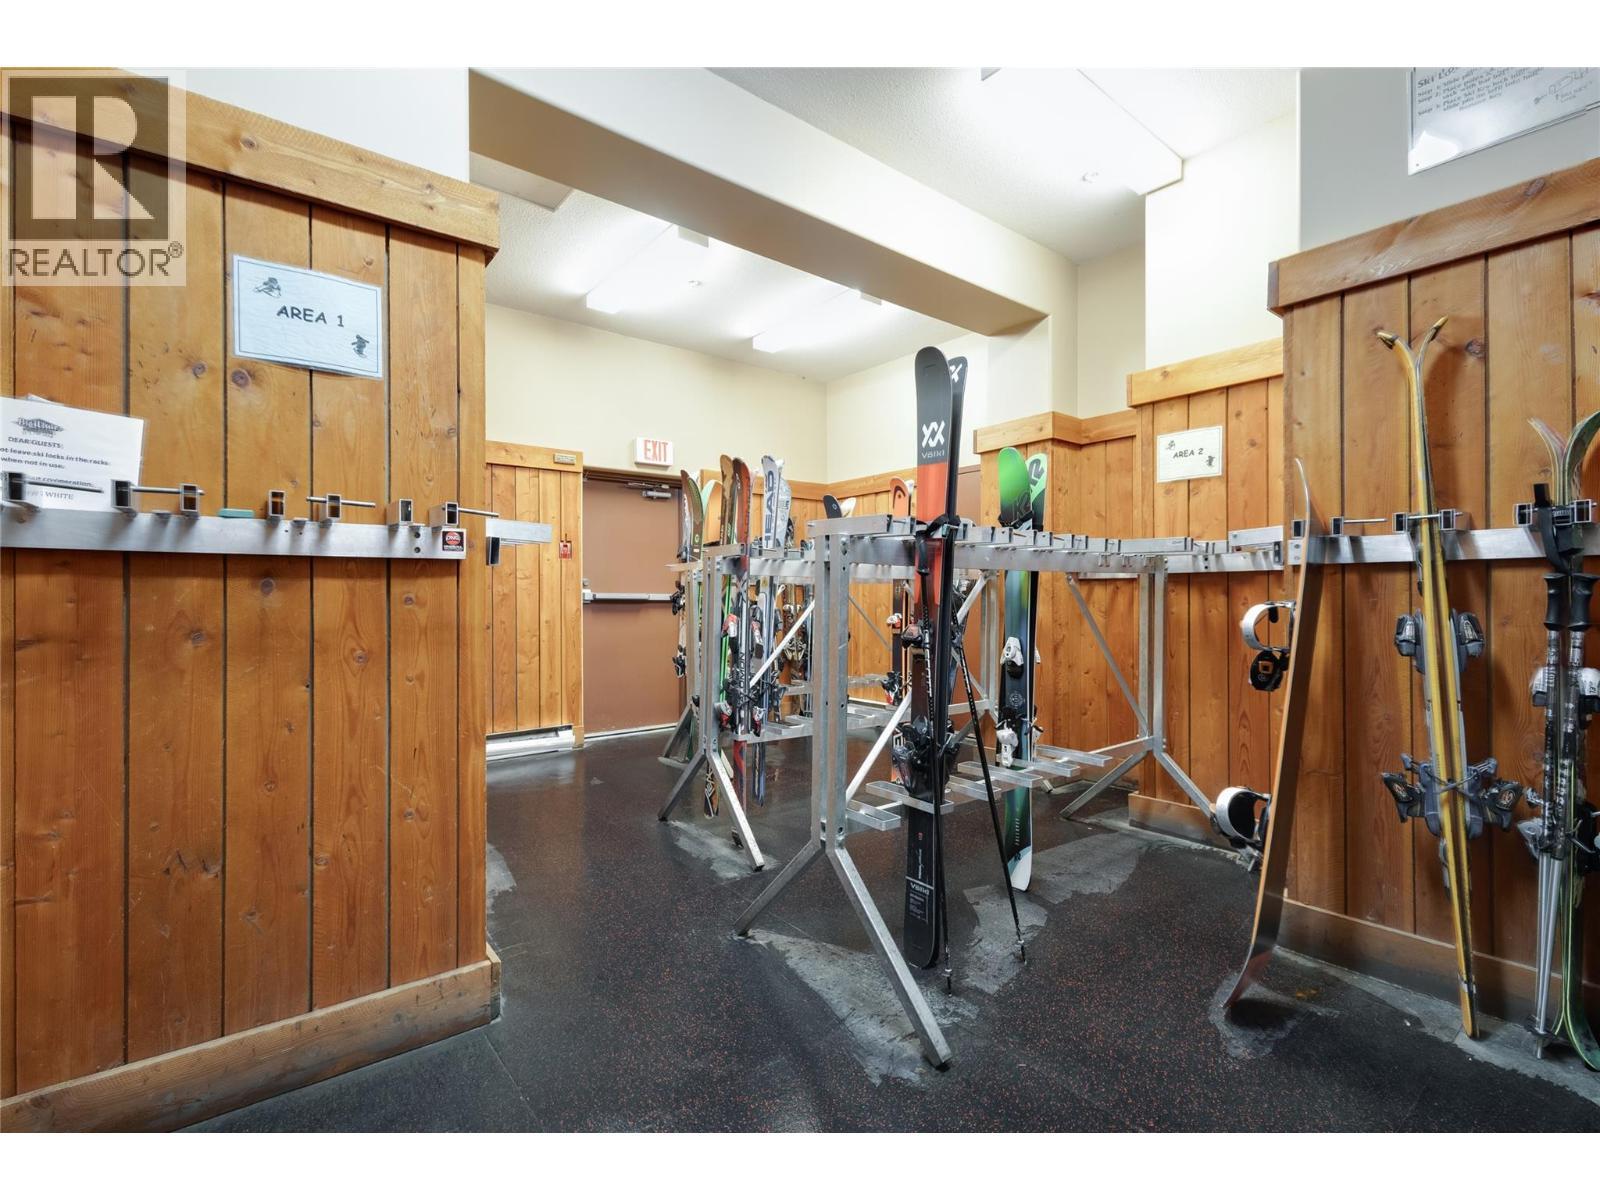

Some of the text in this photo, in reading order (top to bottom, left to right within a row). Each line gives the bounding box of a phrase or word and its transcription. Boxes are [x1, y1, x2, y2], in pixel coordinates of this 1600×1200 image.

[276, 305, 345, 328] AREA 1
[644, 439, 669, 462] EXIT
[1173, 447, 1204, 459] AREA 2
